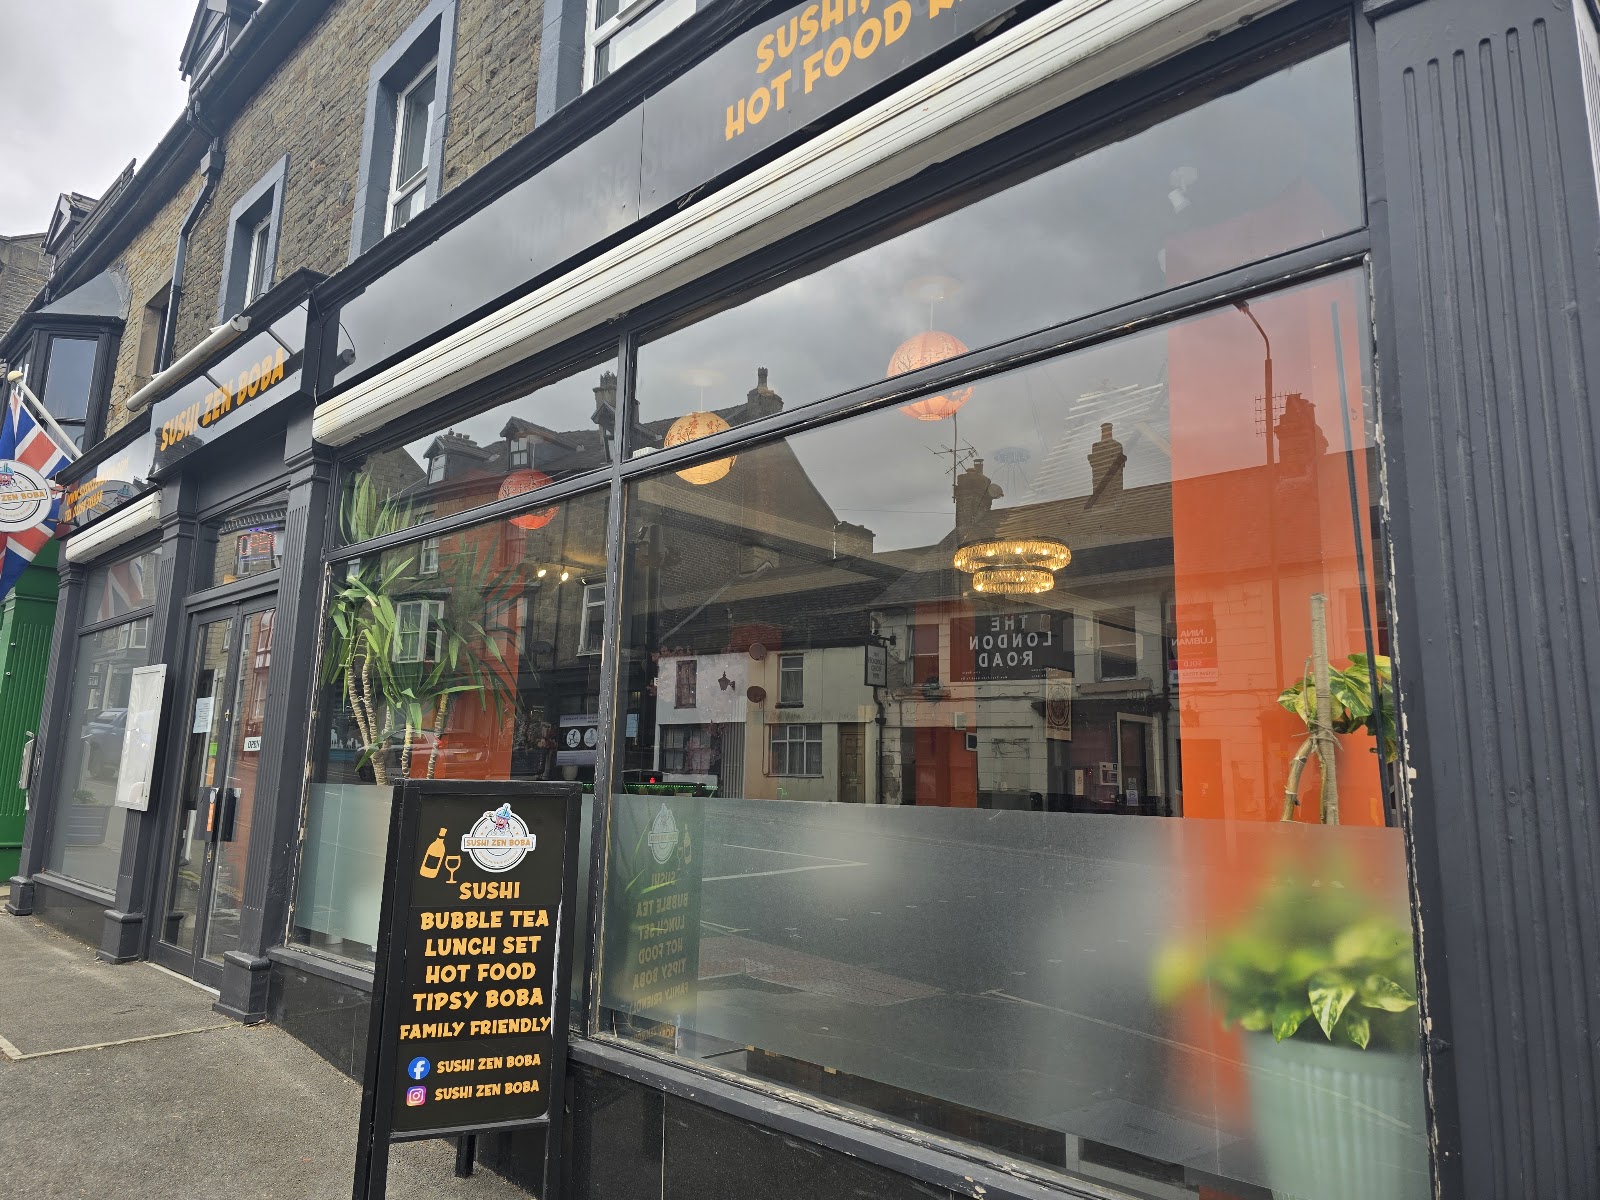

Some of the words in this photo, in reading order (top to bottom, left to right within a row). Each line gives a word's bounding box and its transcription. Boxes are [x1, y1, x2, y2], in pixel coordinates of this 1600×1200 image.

[725, 69, 791, 141] HOT
[803, 0, 911, 94] FOOD
[160, 402, 200, 452] SUSHI
[203, 379, 233, 427] ZEN
[237, 347, 284, 406] BOBA
[1, 494, 19, 502] ZEN
[20, 491, 46, 500] BOBA
[239, 531, 277, 555] OPEN
[248, 739, 260, 749] OPEN
[459, 882, 520, 900] SUSHI
[421, 911, 503, 930] BUBBLE
[510, 910, 549, 927] TEA
[425, 937, 496, 956] LUNCH
[503, 936, 541, 954] SET
[425, 964, 471, 983] HOT
[477, 962, 536, 982] FOOD
[413, 991, 478, 1011] TIPSY
[485, 988, 544, 1008] BOBA
[400, 1022, 465, 1040] FAMILY
[470, 1016, 551, 1035] FRIENDLY
[437, 1058, 474, 1074] SUSHI
[478, 1057, 503, 1069] ZEN
[506, 1054, 540, 1068] BOBA
[435, 1086, 472, 1101] SUSHI
[476, 1083, 501, 1097] ZEN
[505, 1080, 539, 1094] BOBA
